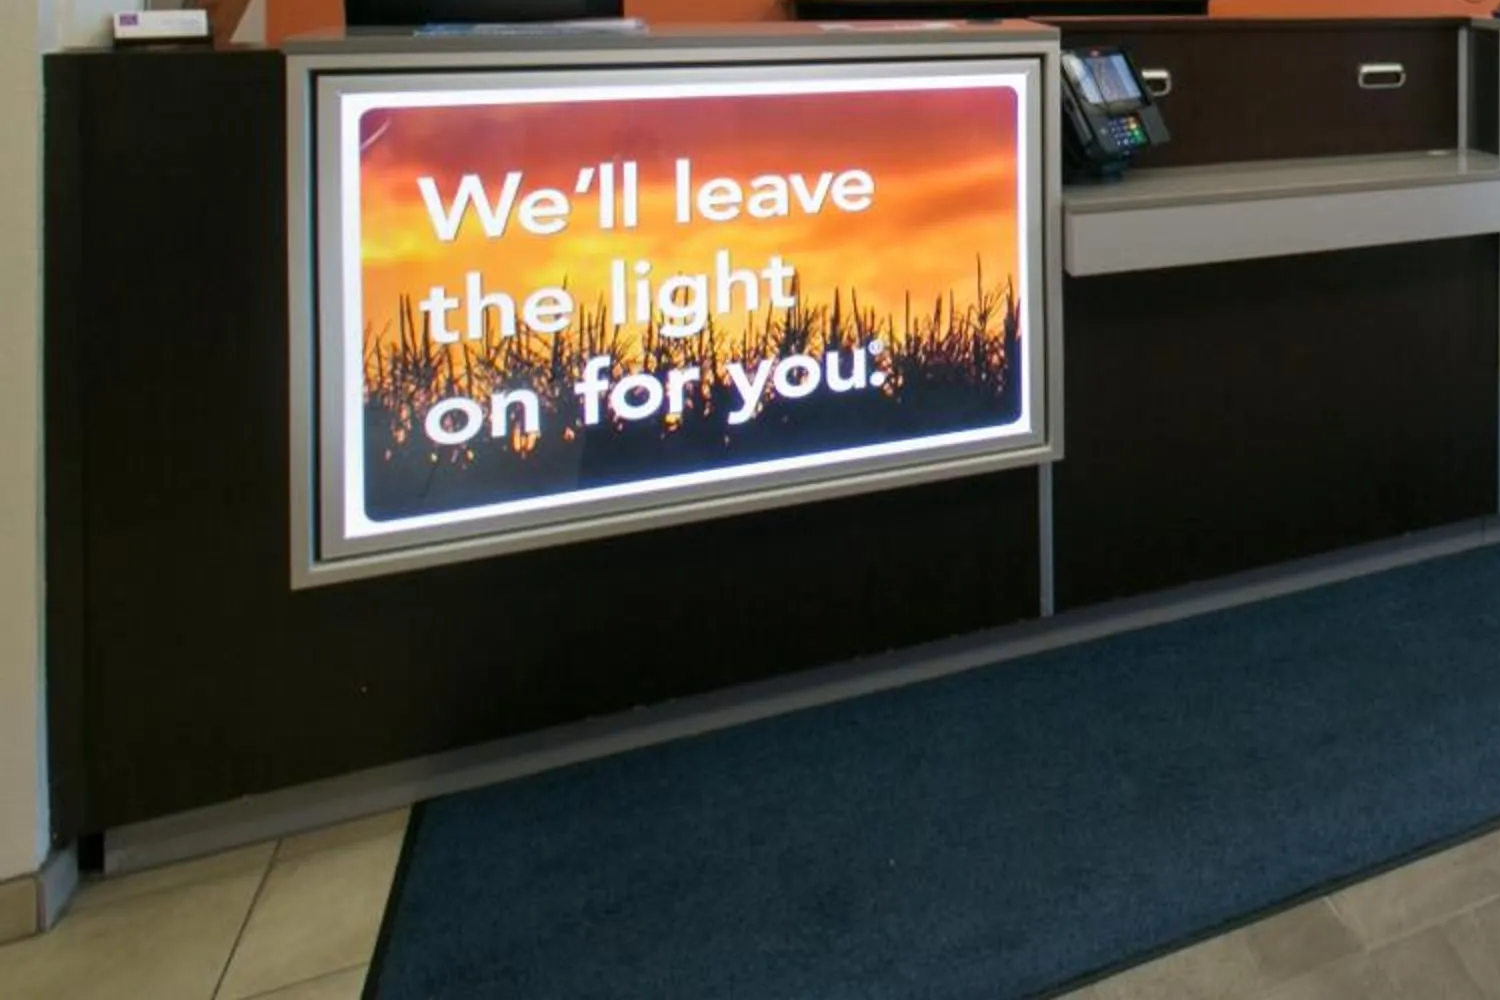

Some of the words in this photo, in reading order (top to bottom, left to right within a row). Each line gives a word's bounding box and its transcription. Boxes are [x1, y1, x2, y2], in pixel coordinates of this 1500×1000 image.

[417, 160, 638, 242] We'll
[674, 157, 876, 224] leave
[418, 271, 573, 345] the
[609, 248, 797, 339] light
[423, 387, 541, 446] on
[574, 355, 703, 425] for
